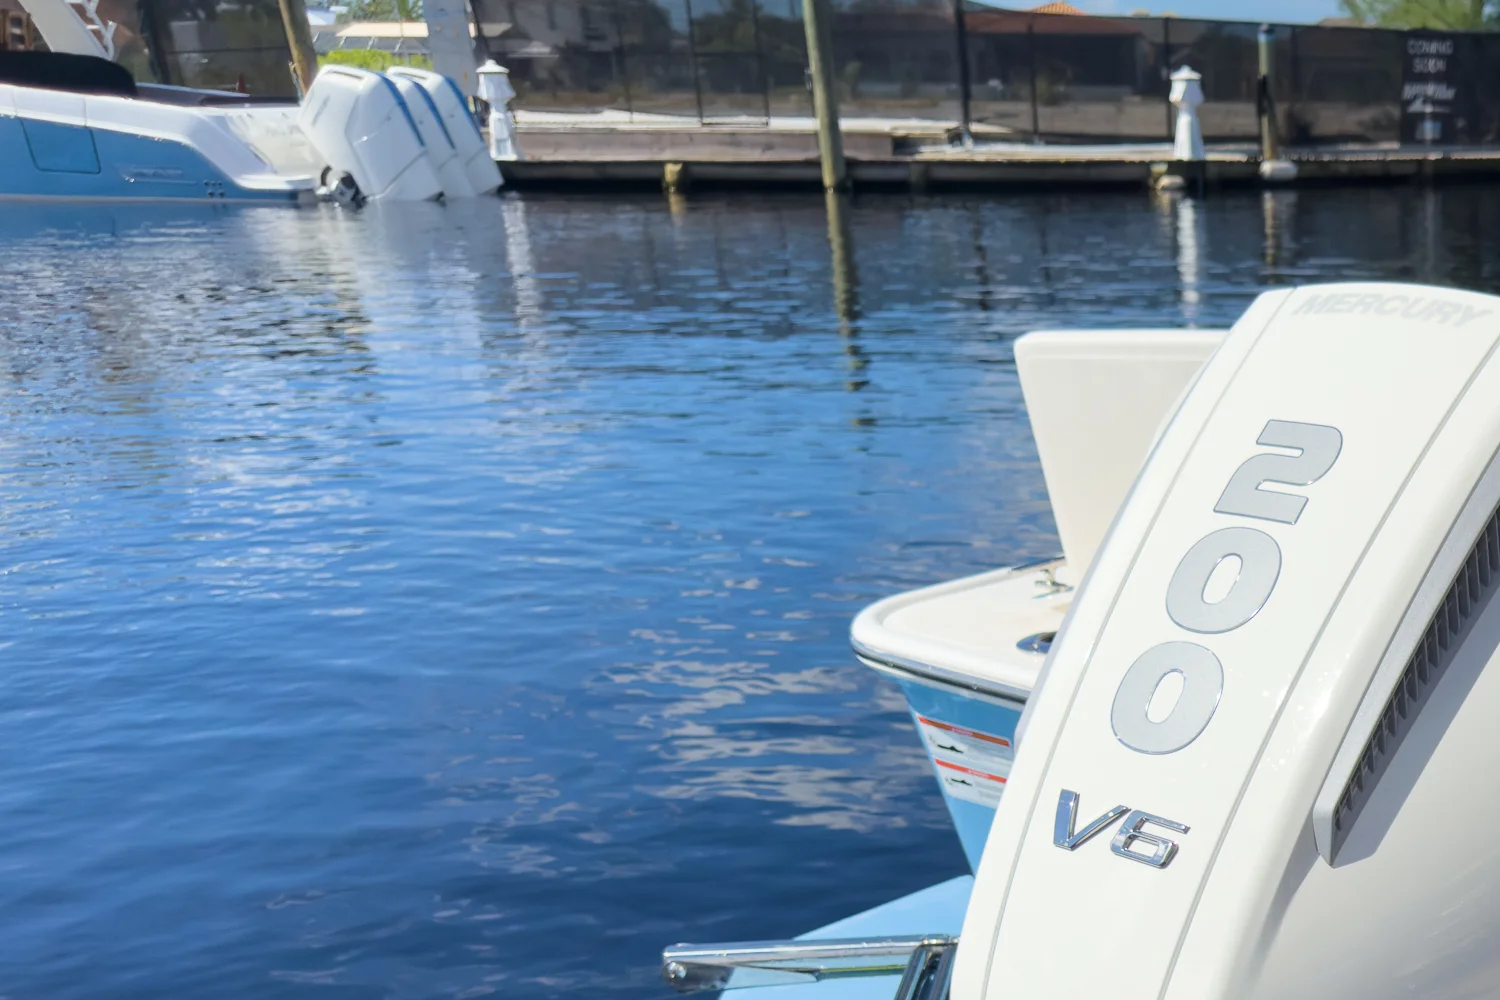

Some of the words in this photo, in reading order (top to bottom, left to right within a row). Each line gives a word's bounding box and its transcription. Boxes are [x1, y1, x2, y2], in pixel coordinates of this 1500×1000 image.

[1291, 293, 1494, 328] MERCURY
[1111, 419, 1344, 756] 200
[1053, 788, 1191, 869] V6
